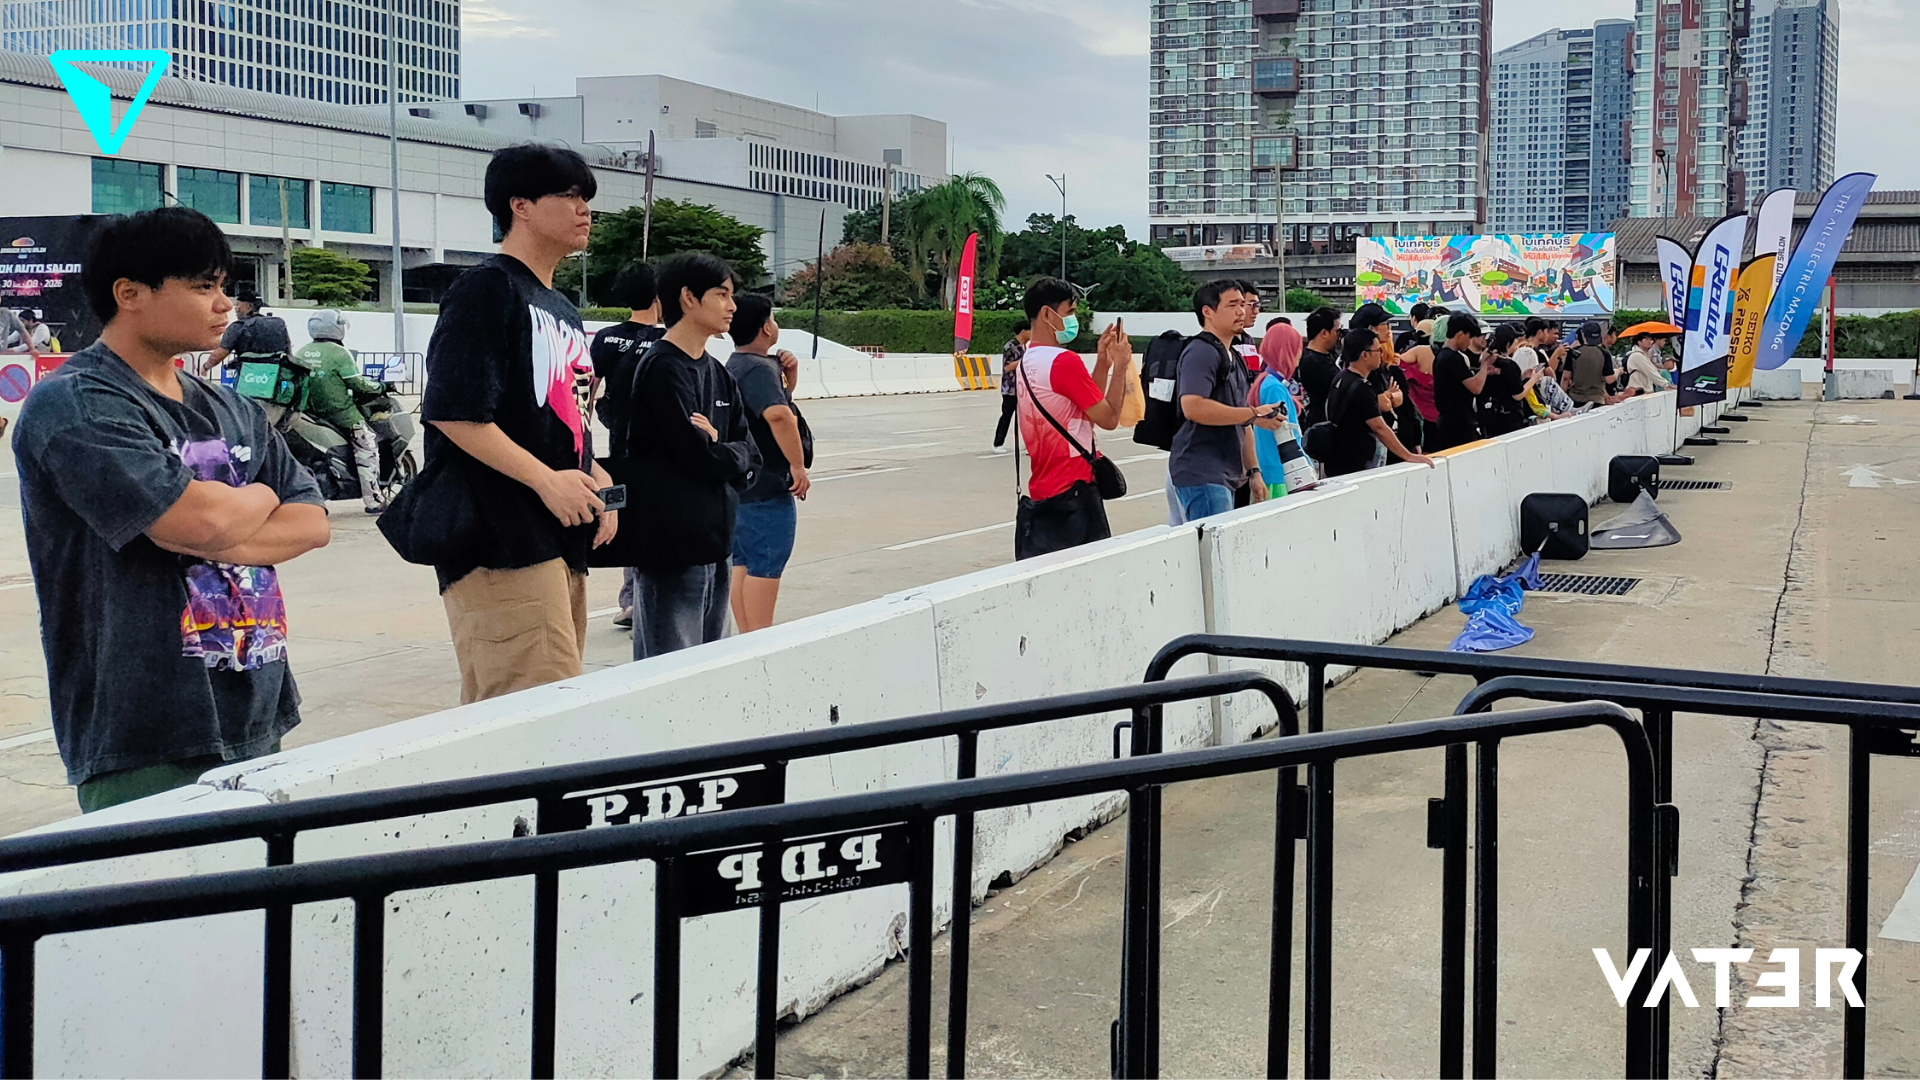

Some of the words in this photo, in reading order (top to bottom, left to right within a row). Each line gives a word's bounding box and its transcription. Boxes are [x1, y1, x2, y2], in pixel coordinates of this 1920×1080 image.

[1833, 194, 1850, 215] THE
[1777, 235, 1786, 262] SALON
[1795, 217, 1837, 295] ALL-ELECTRIC
[14, 263, 45, 273] AUTO
[2, 280, 12, 288] 30
[44, 280, 63, 288] 2026
[961, 279, 969, 309] LEO
[1742, 311, 1759, 355] SEIKO
[1771, 296, 1801, 351] MAZDA6e
[304, 350, 322, 358] Grab
[244, 373, 269, 384] Grab
[585, 777, 740, 830] P.D.P
